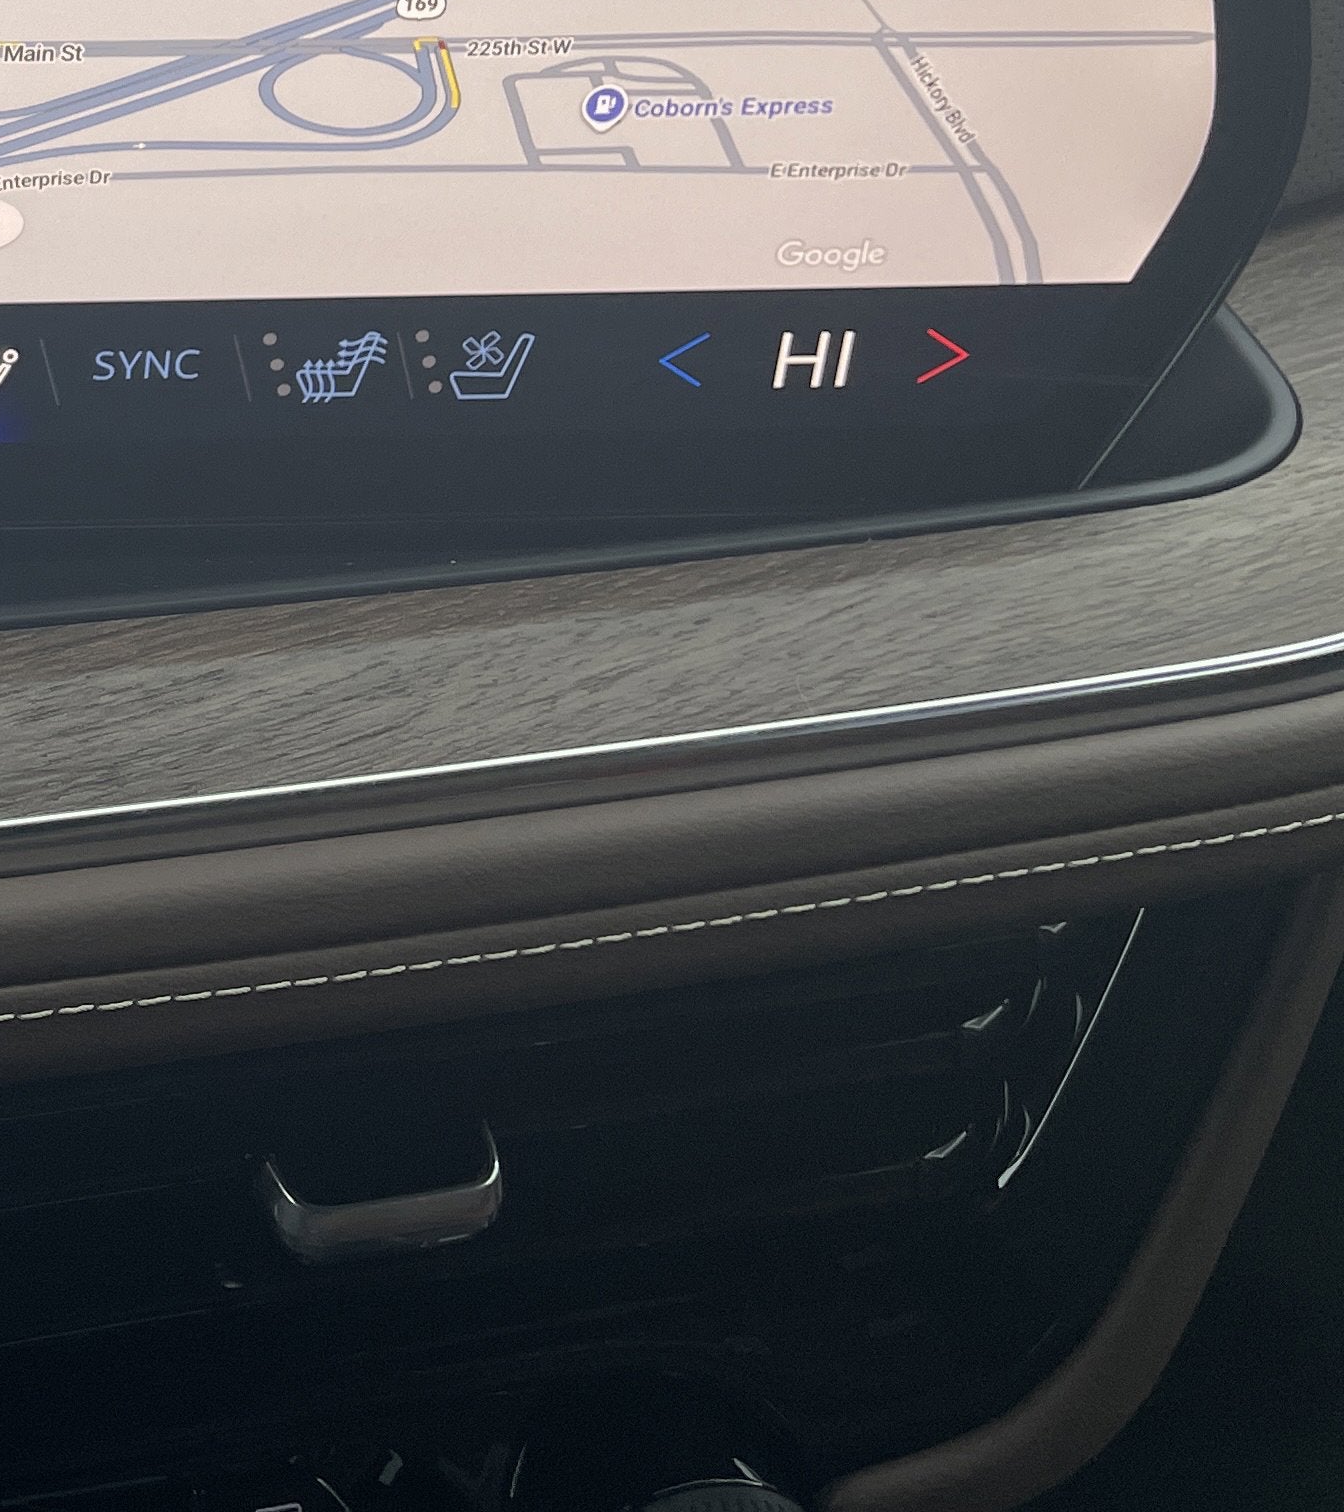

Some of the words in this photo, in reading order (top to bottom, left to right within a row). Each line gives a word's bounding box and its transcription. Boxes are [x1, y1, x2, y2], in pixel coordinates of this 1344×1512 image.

[3, 45, 55, 62] Main
[61, 45, 84, 62] St
[467, 40, 523, 57] 225th
[527, 40, 550, 55] St
[553, 39, 574, 55] W
[634, 98, 733, 118] Coborn's
[741, 98, 834, 119] Express
[911, 56, 951, 118] Hickory
[945, 108, 976, 144] Blvd
[89, 170, 111, 185] Dr
[770, 163, 783, 178] E
[787, 163, 881, 181] Enterprise
[885, 163, 907, 178] Dr
[777, 239, 885, 270] Google
[92, 349, 201, 382] SYNC
[772, 329, 856, 389] HI
